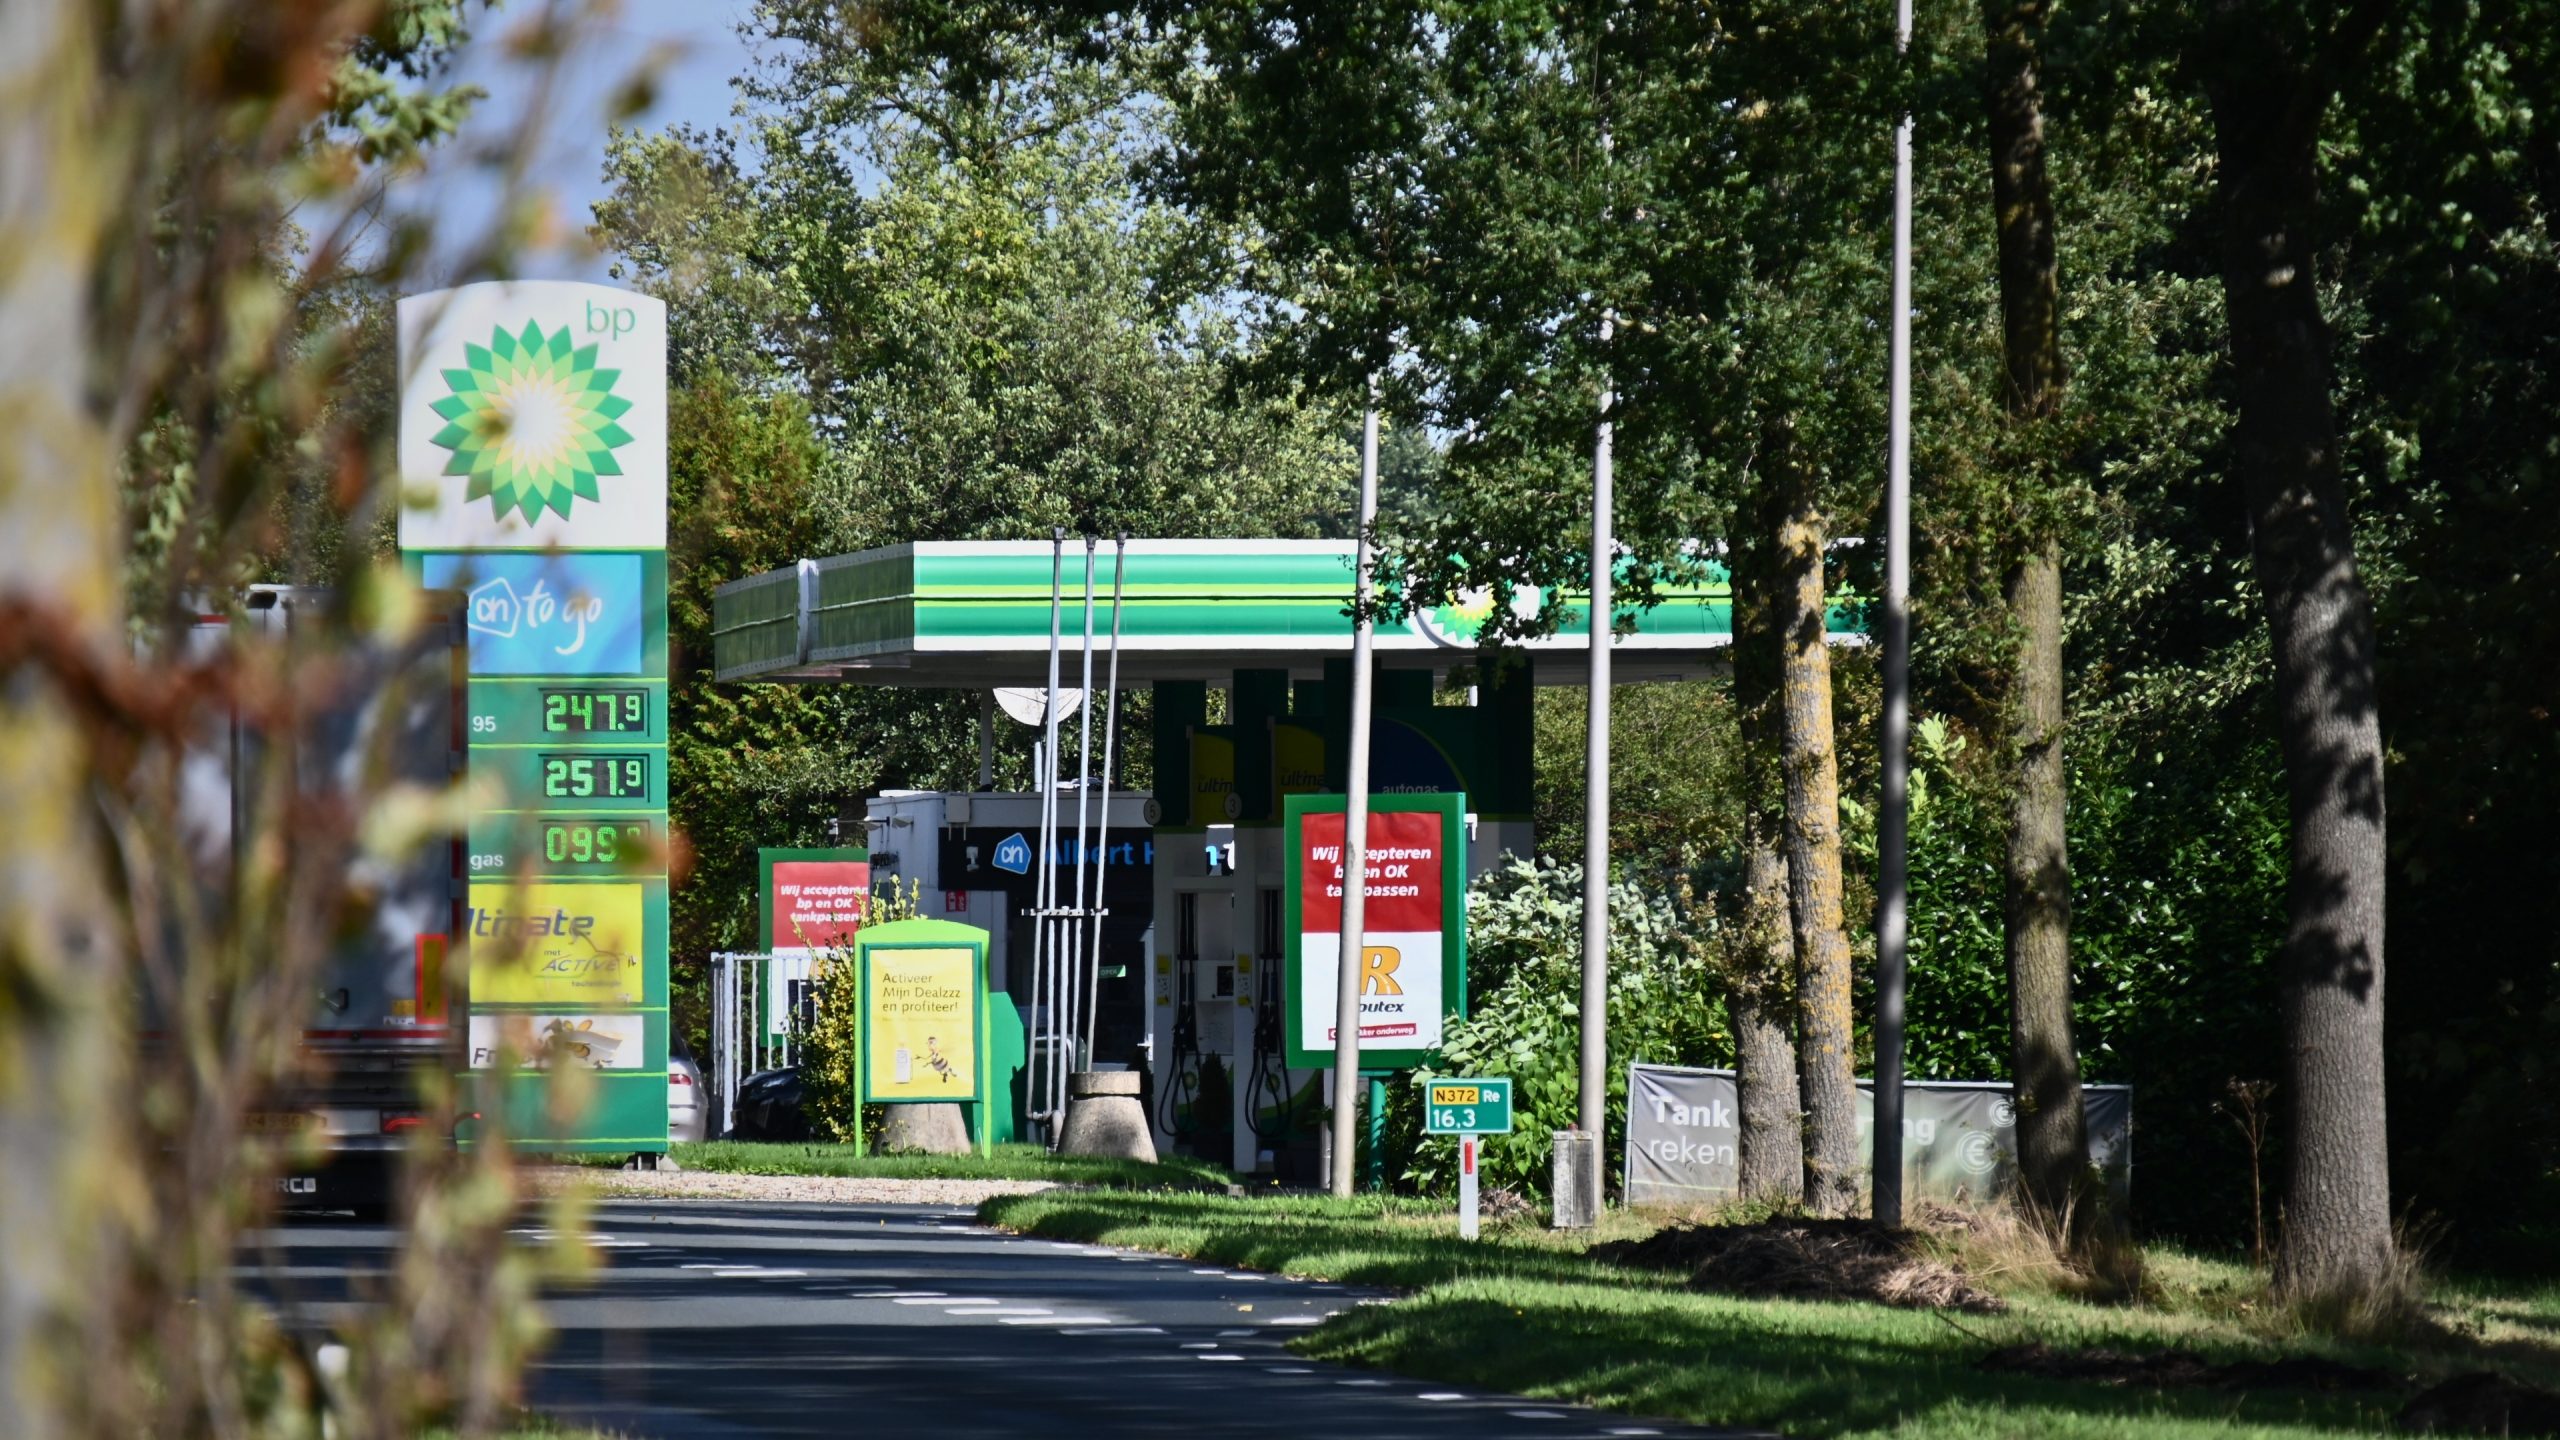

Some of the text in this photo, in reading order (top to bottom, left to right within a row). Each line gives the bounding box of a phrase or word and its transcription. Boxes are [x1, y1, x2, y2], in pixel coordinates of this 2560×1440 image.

[586, 300, 636, 341] bp
[522, 579, 555, 628] to
[472, 716, 496, 732] 95
[1312, 847, 1340, 863] Wij
[1385, 865, 1410, 878] OK
[781, 885, 801, 897] Wij
[1326, 884, 1419, 897] tapassen
[796, 898, 854, 910] bp en OK
[882, 973, 933, 984] Activeer
[883, 987, 961, 999] Mijn Dealzzz
[882, 1000, 959, 1014] en profiteer!
[1359, 1001, 1405, 1013] outex
[1435, 1089, 1500, 1103] N372 Re
[1433, 1109, 1476, 1128] 16,3
[1650, 1095, 1731, 1128] Tank
[1650, 1135, 1735, 1166] reken
